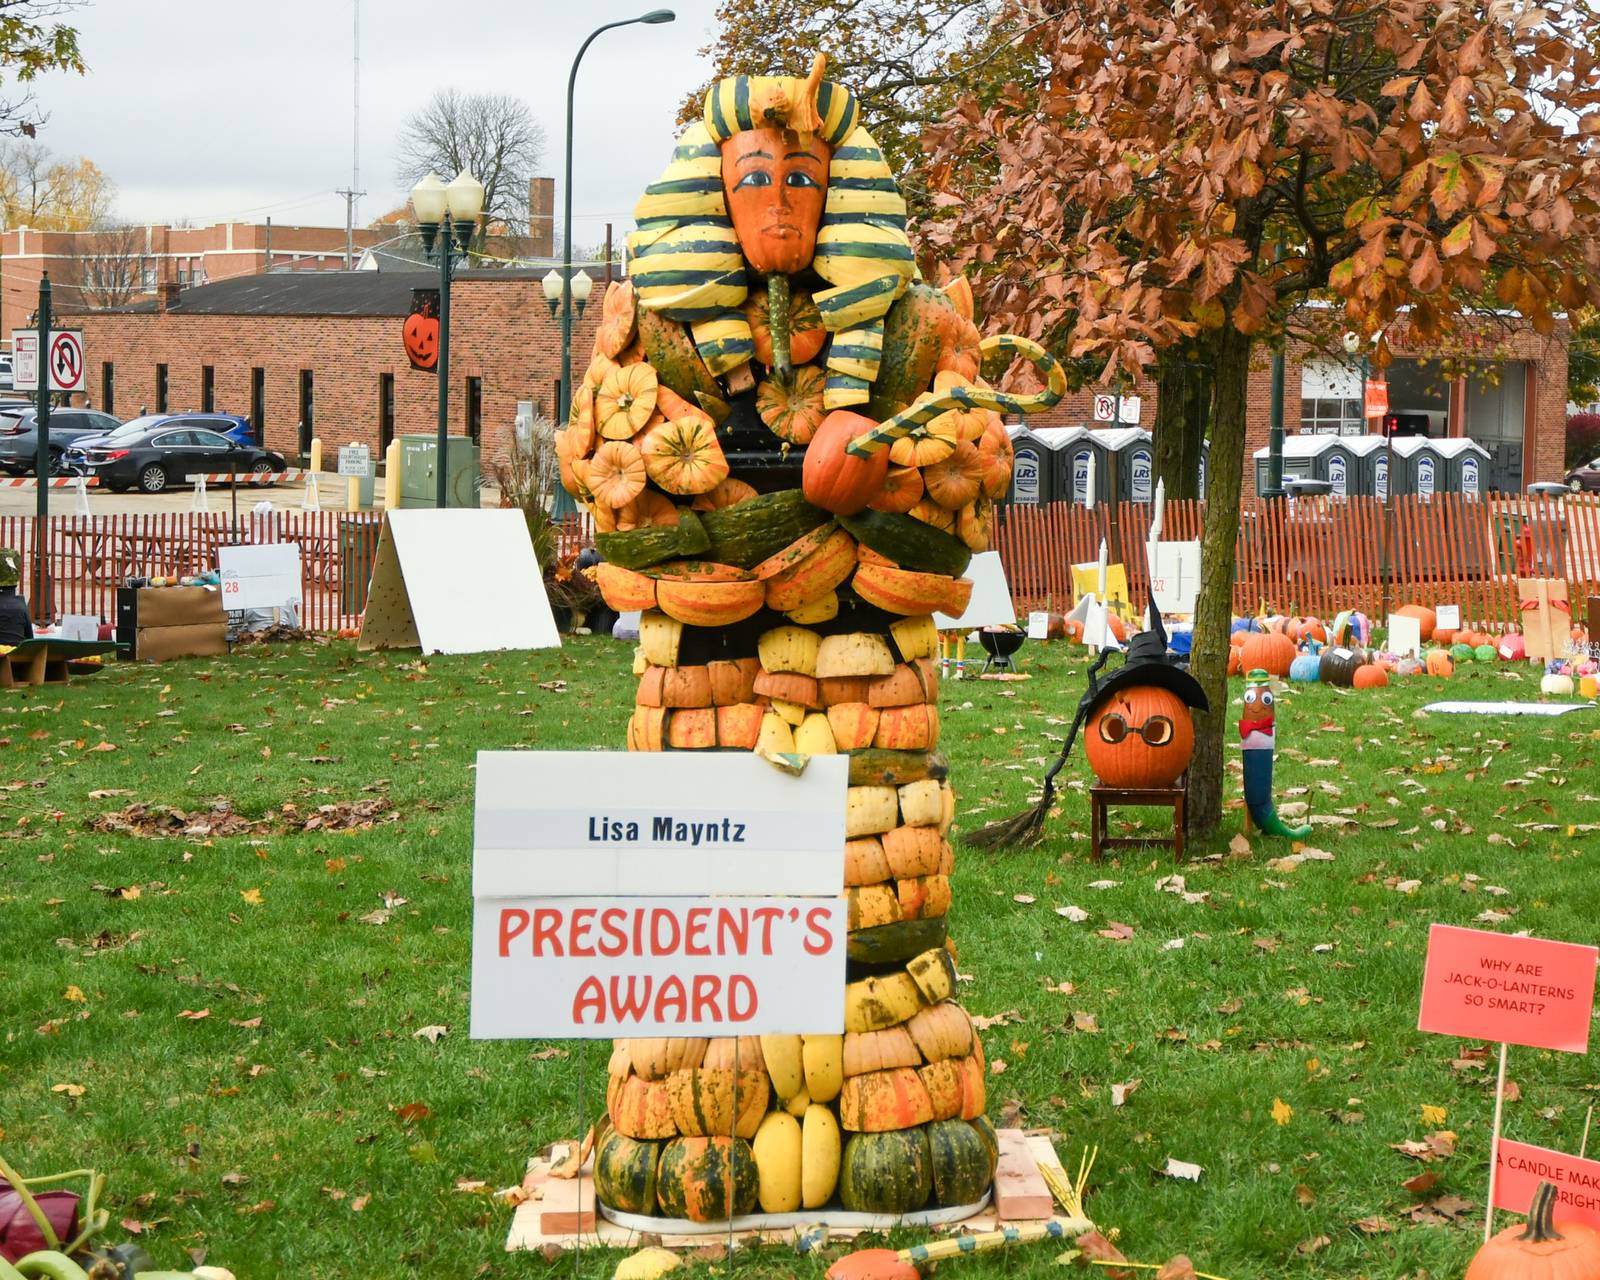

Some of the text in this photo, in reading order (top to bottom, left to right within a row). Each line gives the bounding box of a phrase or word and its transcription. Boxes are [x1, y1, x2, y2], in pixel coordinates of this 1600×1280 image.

[1017, 469, 1036, 478] LRS
[1076, 471, 1088, 479] LR
[1134, 470, 1150, 478] LRS
[225, 582, 238, 593] 28
[1153, 579, 1164, 592] 27
[588, 816, 746, 846] Lisa Mayntz
[498, 907, 834, 957] PRESIDENT'S
[1480, 957, 1544, 977] WHY ARE
[1444, 972, 1575, 1000] JACK-O-LANTERNS
[572, 974, 758, 1024] AWARD
[1464, 994, 1546, 1016] SO SMART?
[1508, 1156, 1564, 1181] CANDLE
